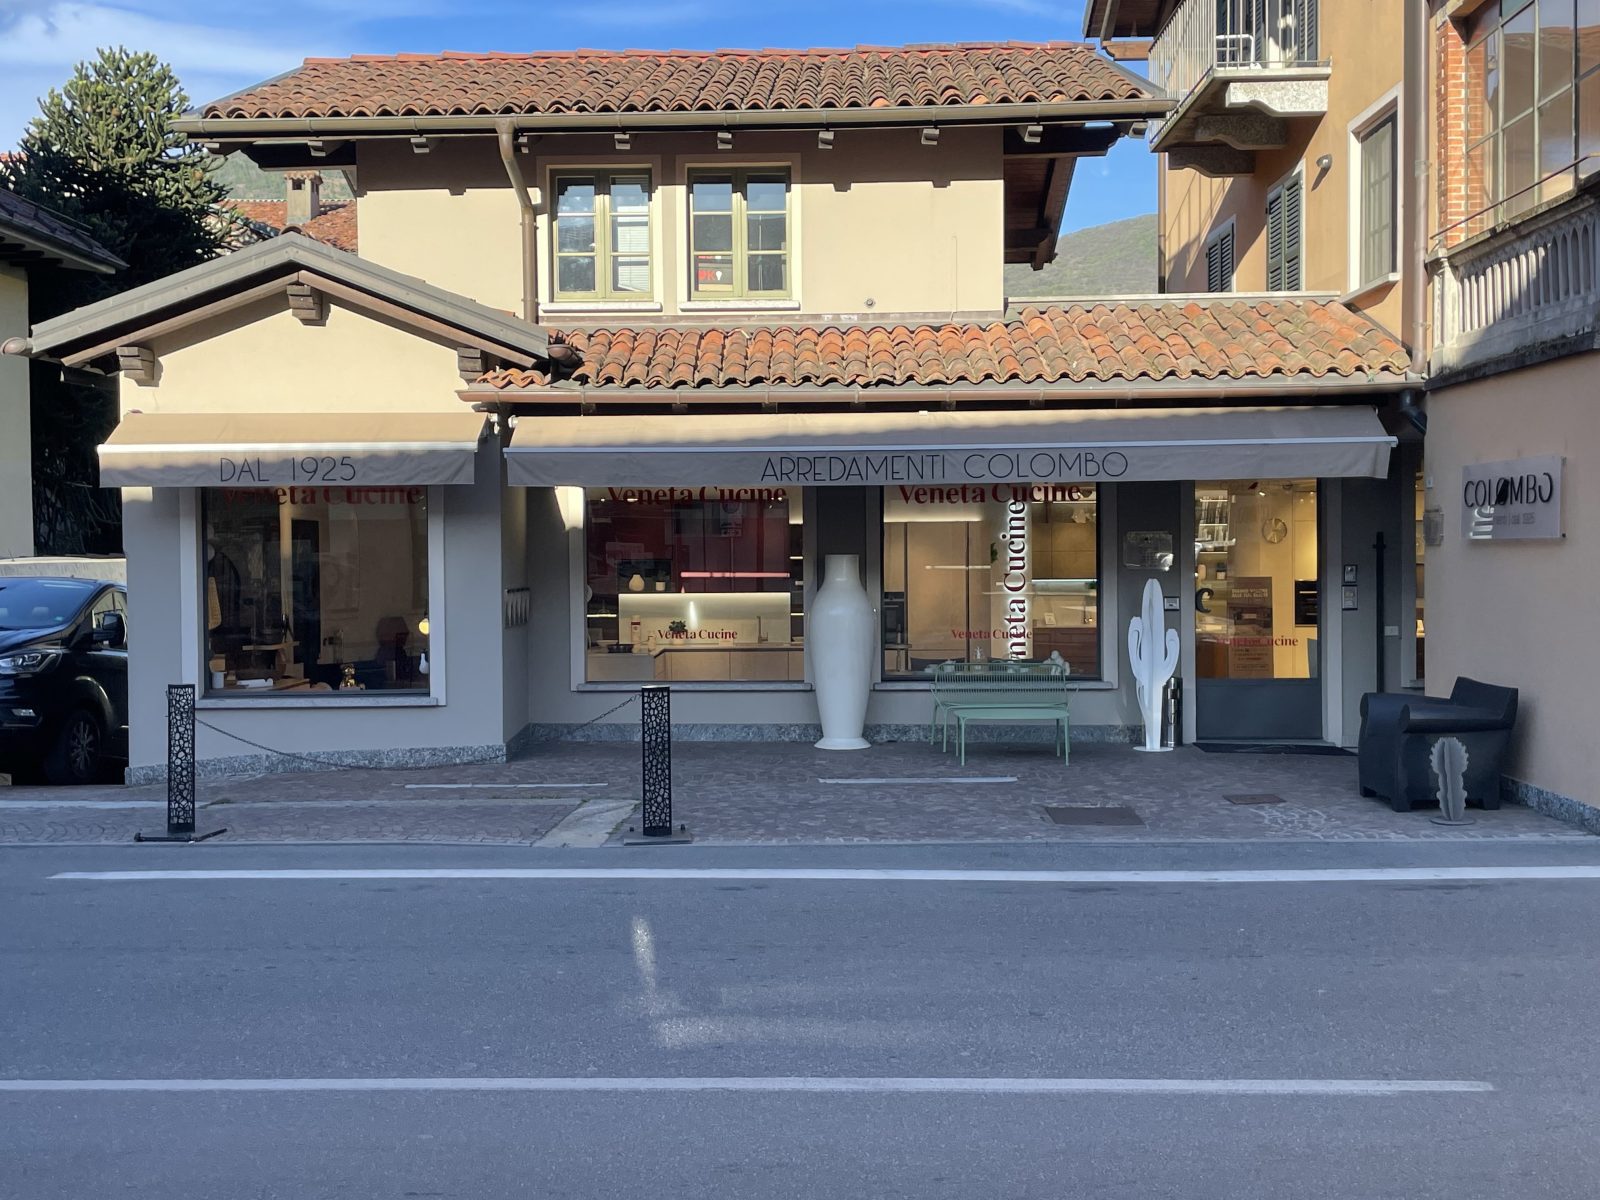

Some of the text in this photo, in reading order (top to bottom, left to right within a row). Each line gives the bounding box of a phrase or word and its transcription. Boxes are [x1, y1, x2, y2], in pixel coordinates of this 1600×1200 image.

[219, 456, 356, 482] DAL 1925
[761, 451, 1129, 482] ARREDAMENTI COLOMBO
[607, 486, 787, 506] Veneta Cucine
[900, 482, 1081, 505] Veneta Cucine
[1463, 471, 1554, 508] COLOMBO
[1001, 500, 1027, 593] Cucine
[698, 628, 738, 640] Cucine
[951, 629, 991, 640] Veneta
